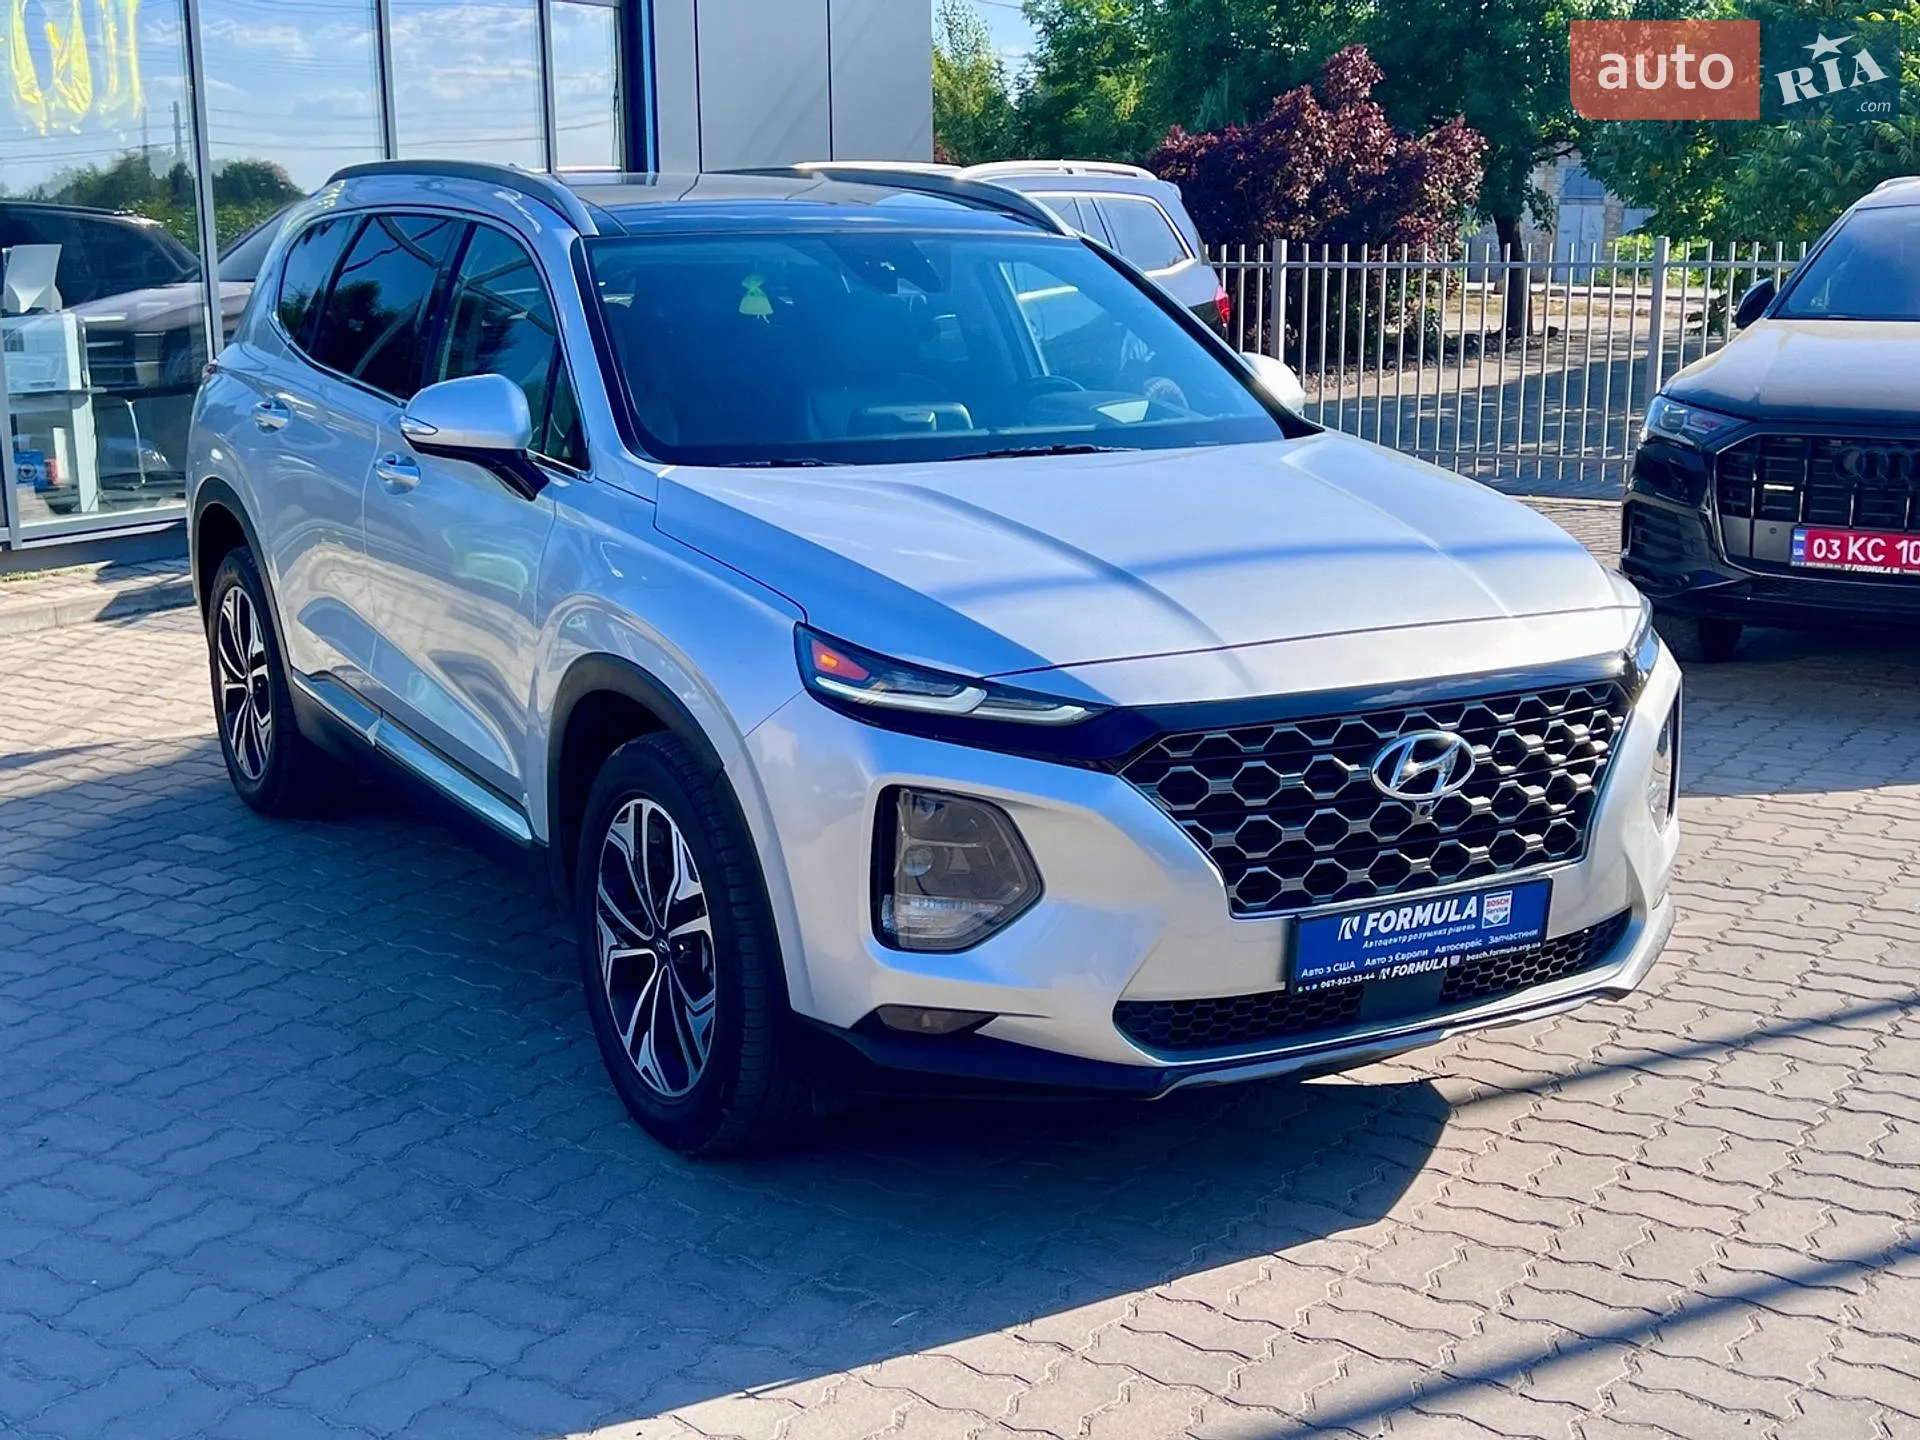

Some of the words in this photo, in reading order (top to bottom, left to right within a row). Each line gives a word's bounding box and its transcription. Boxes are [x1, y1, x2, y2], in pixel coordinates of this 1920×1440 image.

[1813, 538, 1841, 560] 03
[1847, 536, 1887, 563] KC
[1895, 539, 1920, 565] 10
[1851, 564, 1891, 574] FORMULA
[1486, 897, 1510, 908] BOSCH
[1486, 906, 1509, 916] Service
[1363, 896, 1478, 937] FORMULA
[1488, 928, 1539, 945] Запчастини
[1434, 938, 1483, 954] Автосервіс
[1364, 956, 1388, 967] Авто
[1395, 948, 1429, 962] Європи
[1301, 968, 1324, 978] Авто
[1333, 960, 1357, 973] США
[1391, 956, 1448, 979] FORMULA
